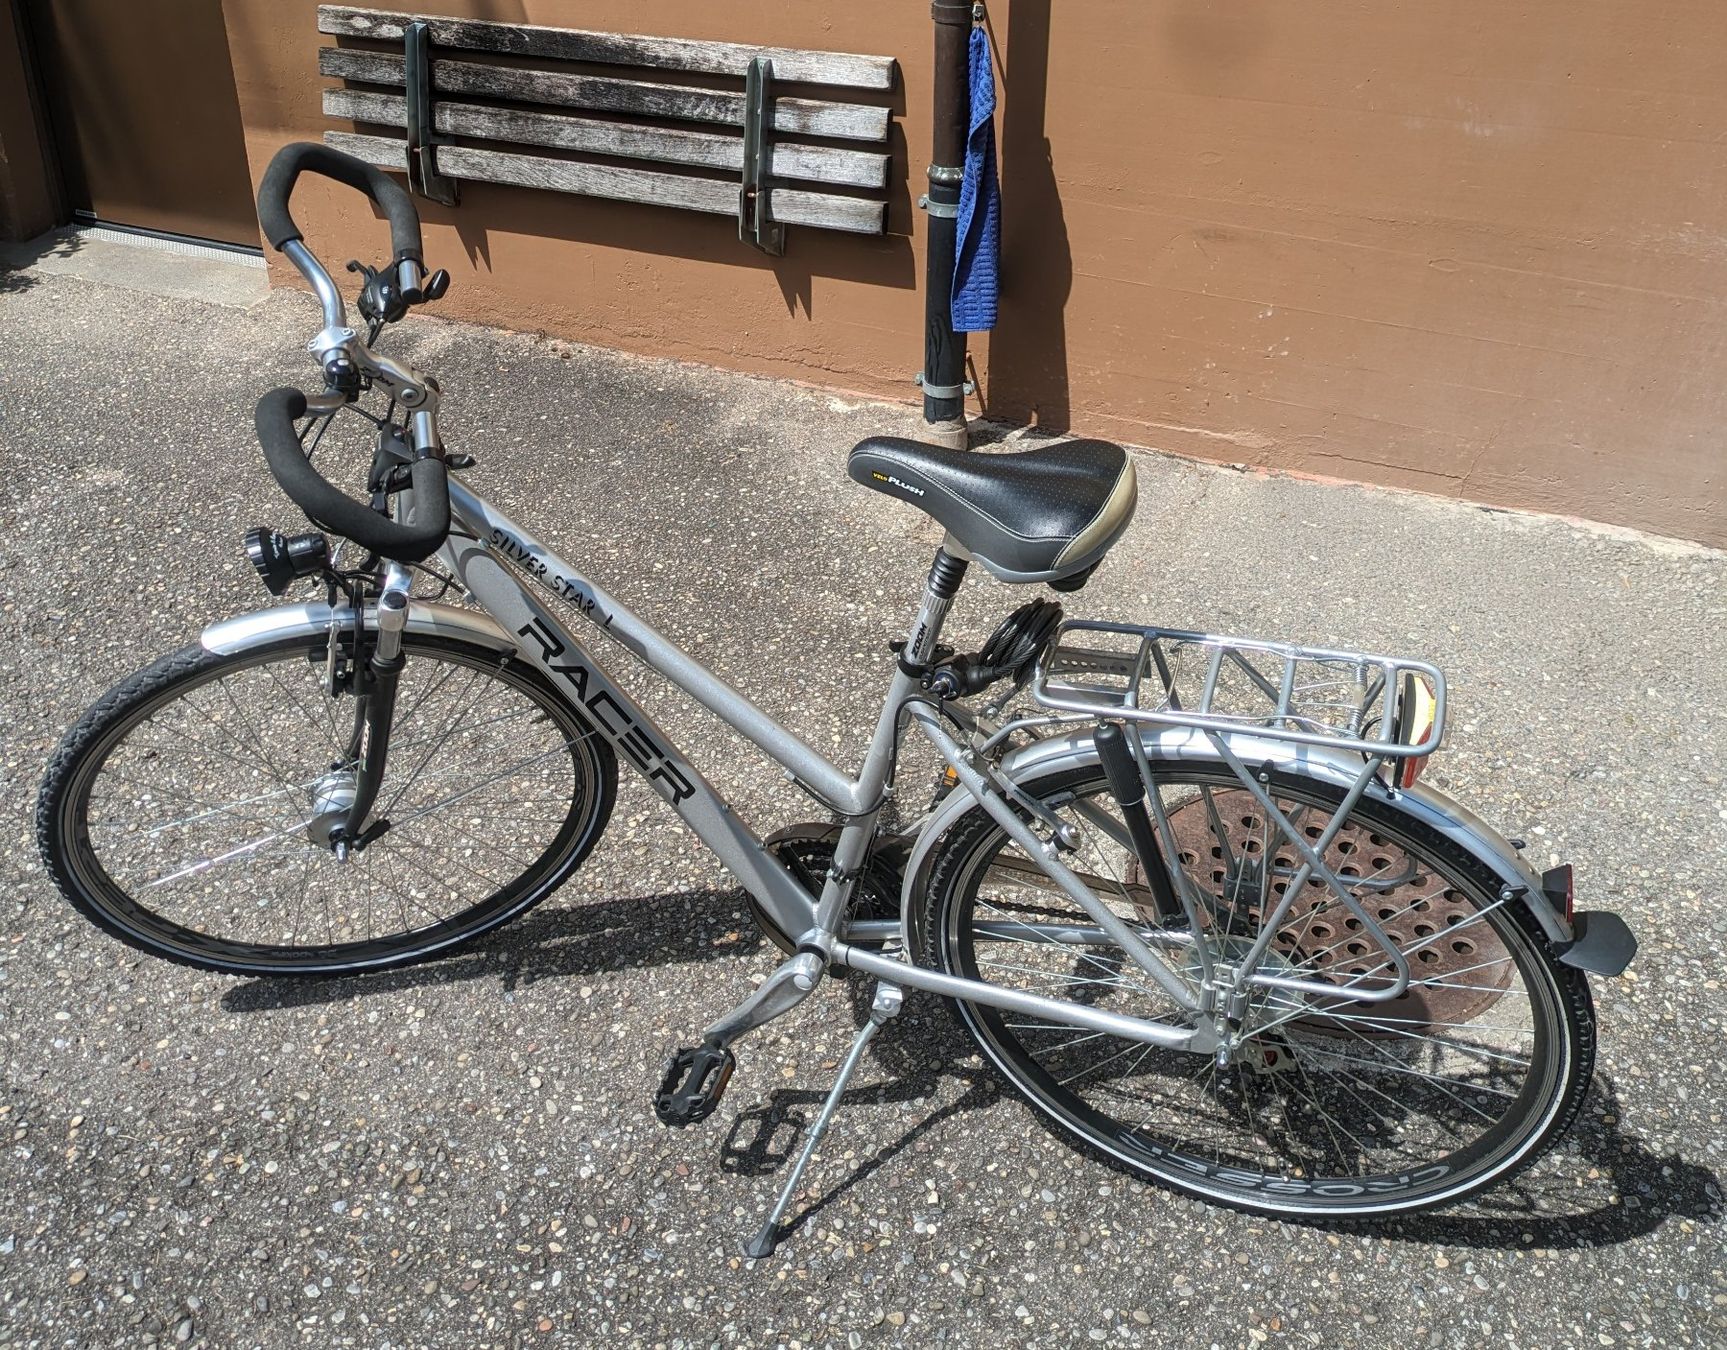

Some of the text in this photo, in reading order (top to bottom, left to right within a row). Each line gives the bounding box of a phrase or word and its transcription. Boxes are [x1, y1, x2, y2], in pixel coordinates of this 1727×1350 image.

[887, 476, 924, 497] PLUSH
[489, 529, 548, 582] SILVER
[552, 575, 595, 616] STAR
[911, 622, 928, 657] ZOOM
[517, 617, 696, 805] RACER
[1118, 1131, 1450, 1197] CROSSER
